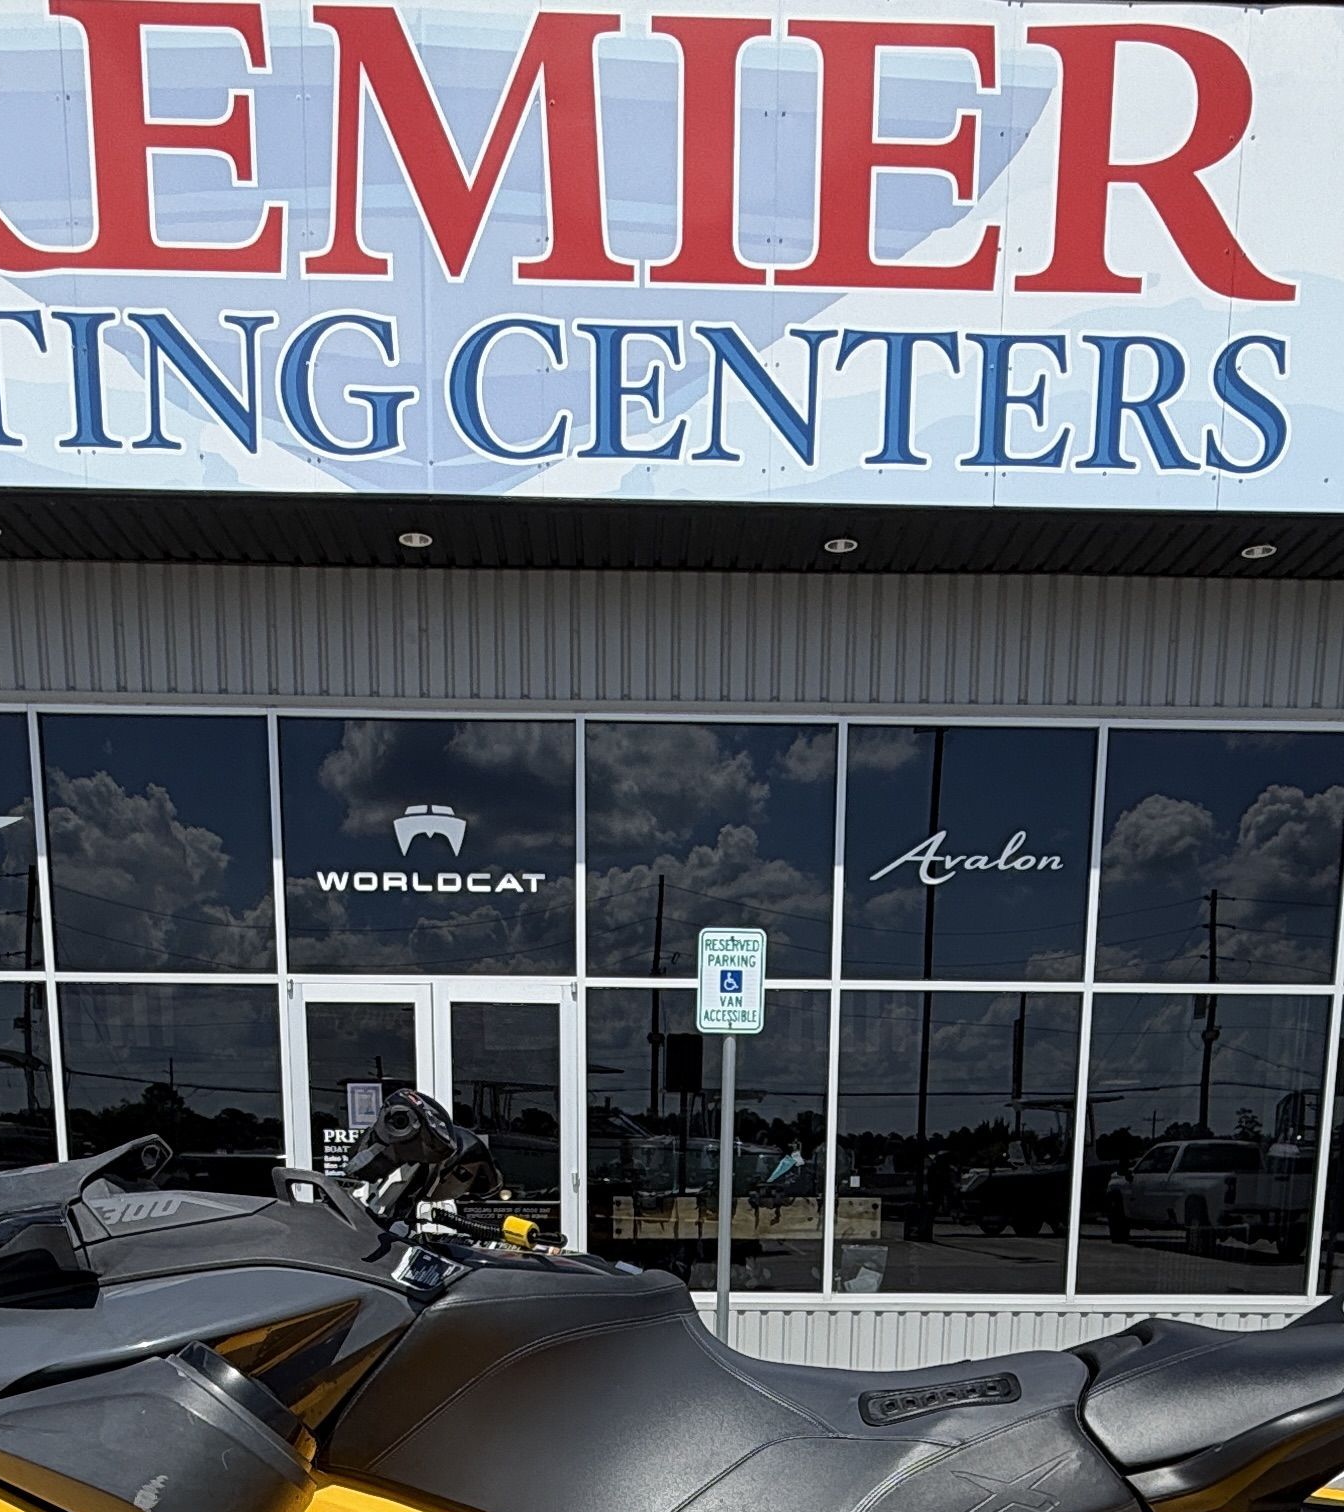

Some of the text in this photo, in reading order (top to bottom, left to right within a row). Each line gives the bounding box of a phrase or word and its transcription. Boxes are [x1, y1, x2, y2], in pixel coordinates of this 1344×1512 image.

[454, 317, 1289, 473] CENTERS
[869, 830, 1064, 886] Avalon
[316, 871, 546, 893] WORLDCAT
[704, 938, 759, 952] RESERVED
[707, 953, 756, 967] PARKING
[719, 995, 743, 1007] VAN
[703, 1008, 757, 1022] ACCESSIBLE
